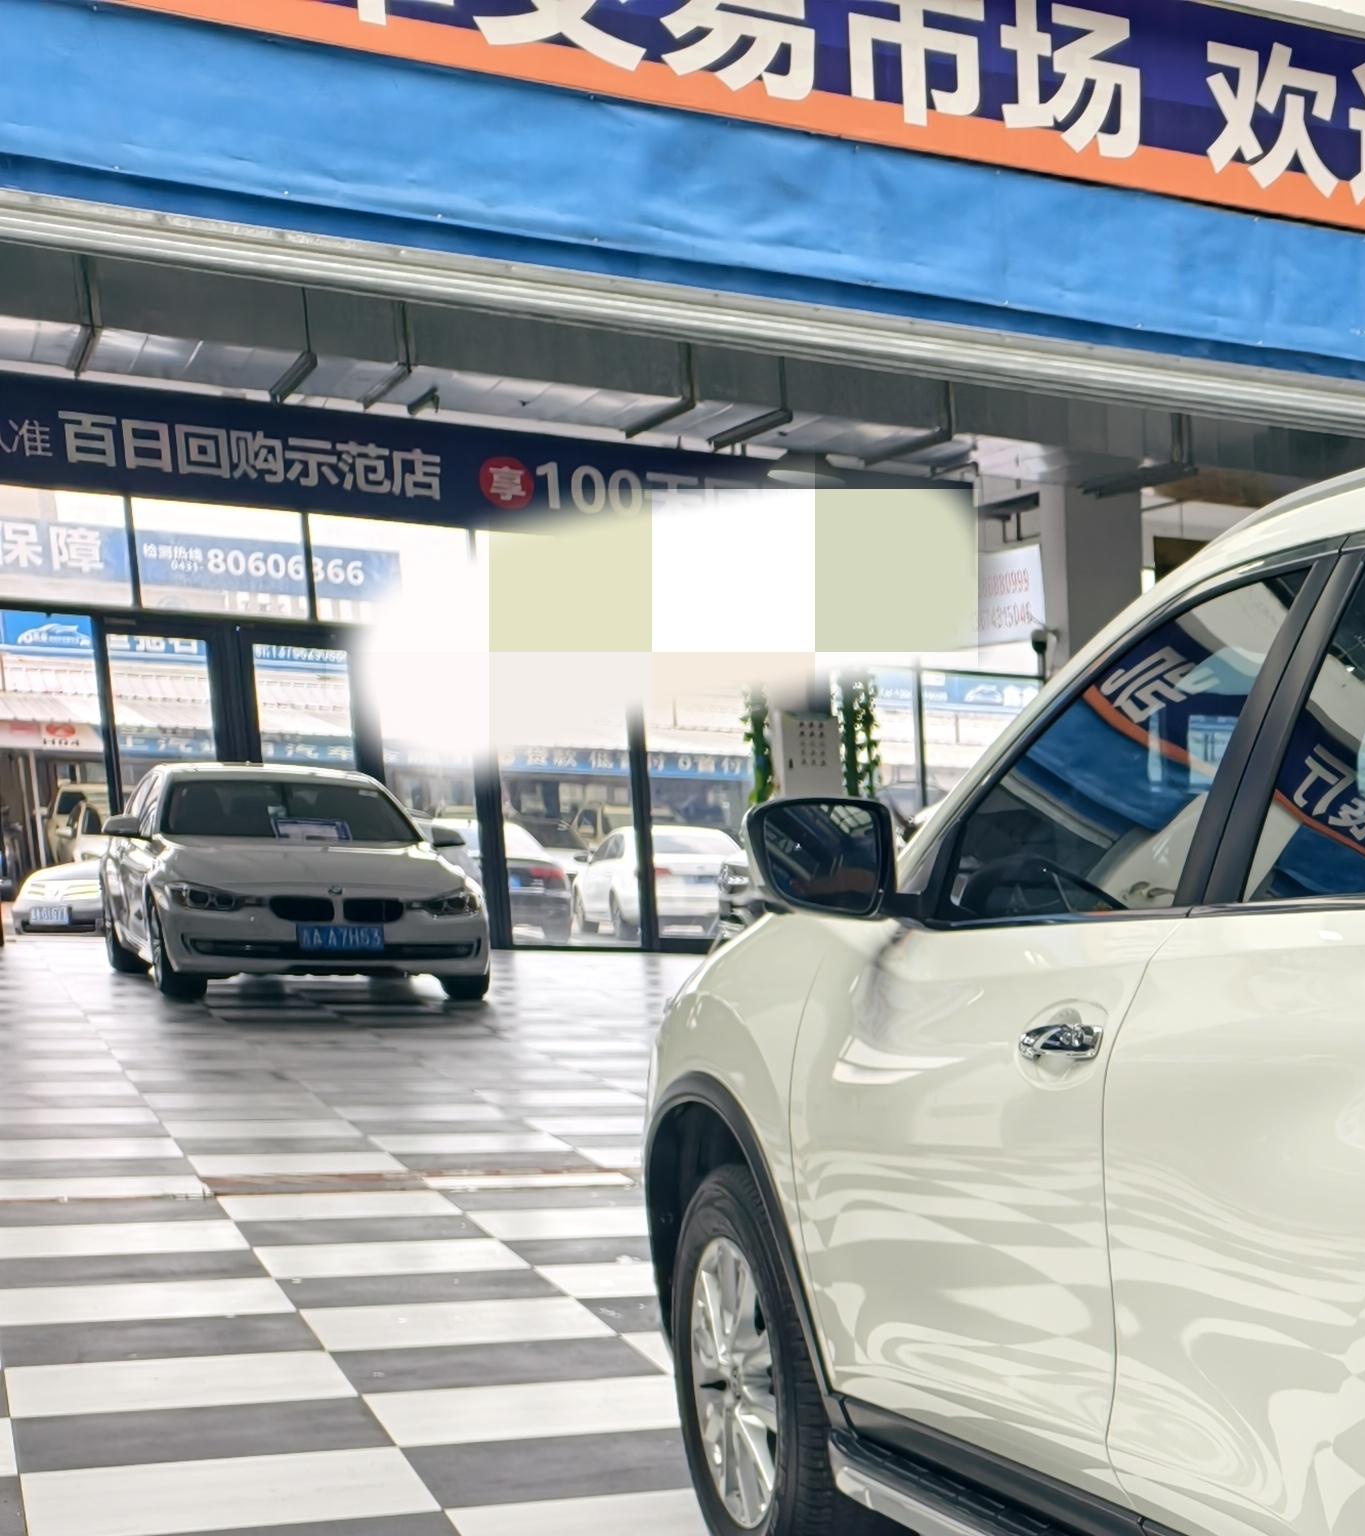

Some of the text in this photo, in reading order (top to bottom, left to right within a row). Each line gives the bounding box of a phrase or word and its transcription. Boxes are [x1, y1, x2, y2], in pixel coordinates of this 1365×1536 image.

[356, 0, 1141, 158] 易市场
[0, 418, 53, 458] 准
[58, 410, 442, 500] 百日回购示范店
[489, 465, 526, 501] 享
